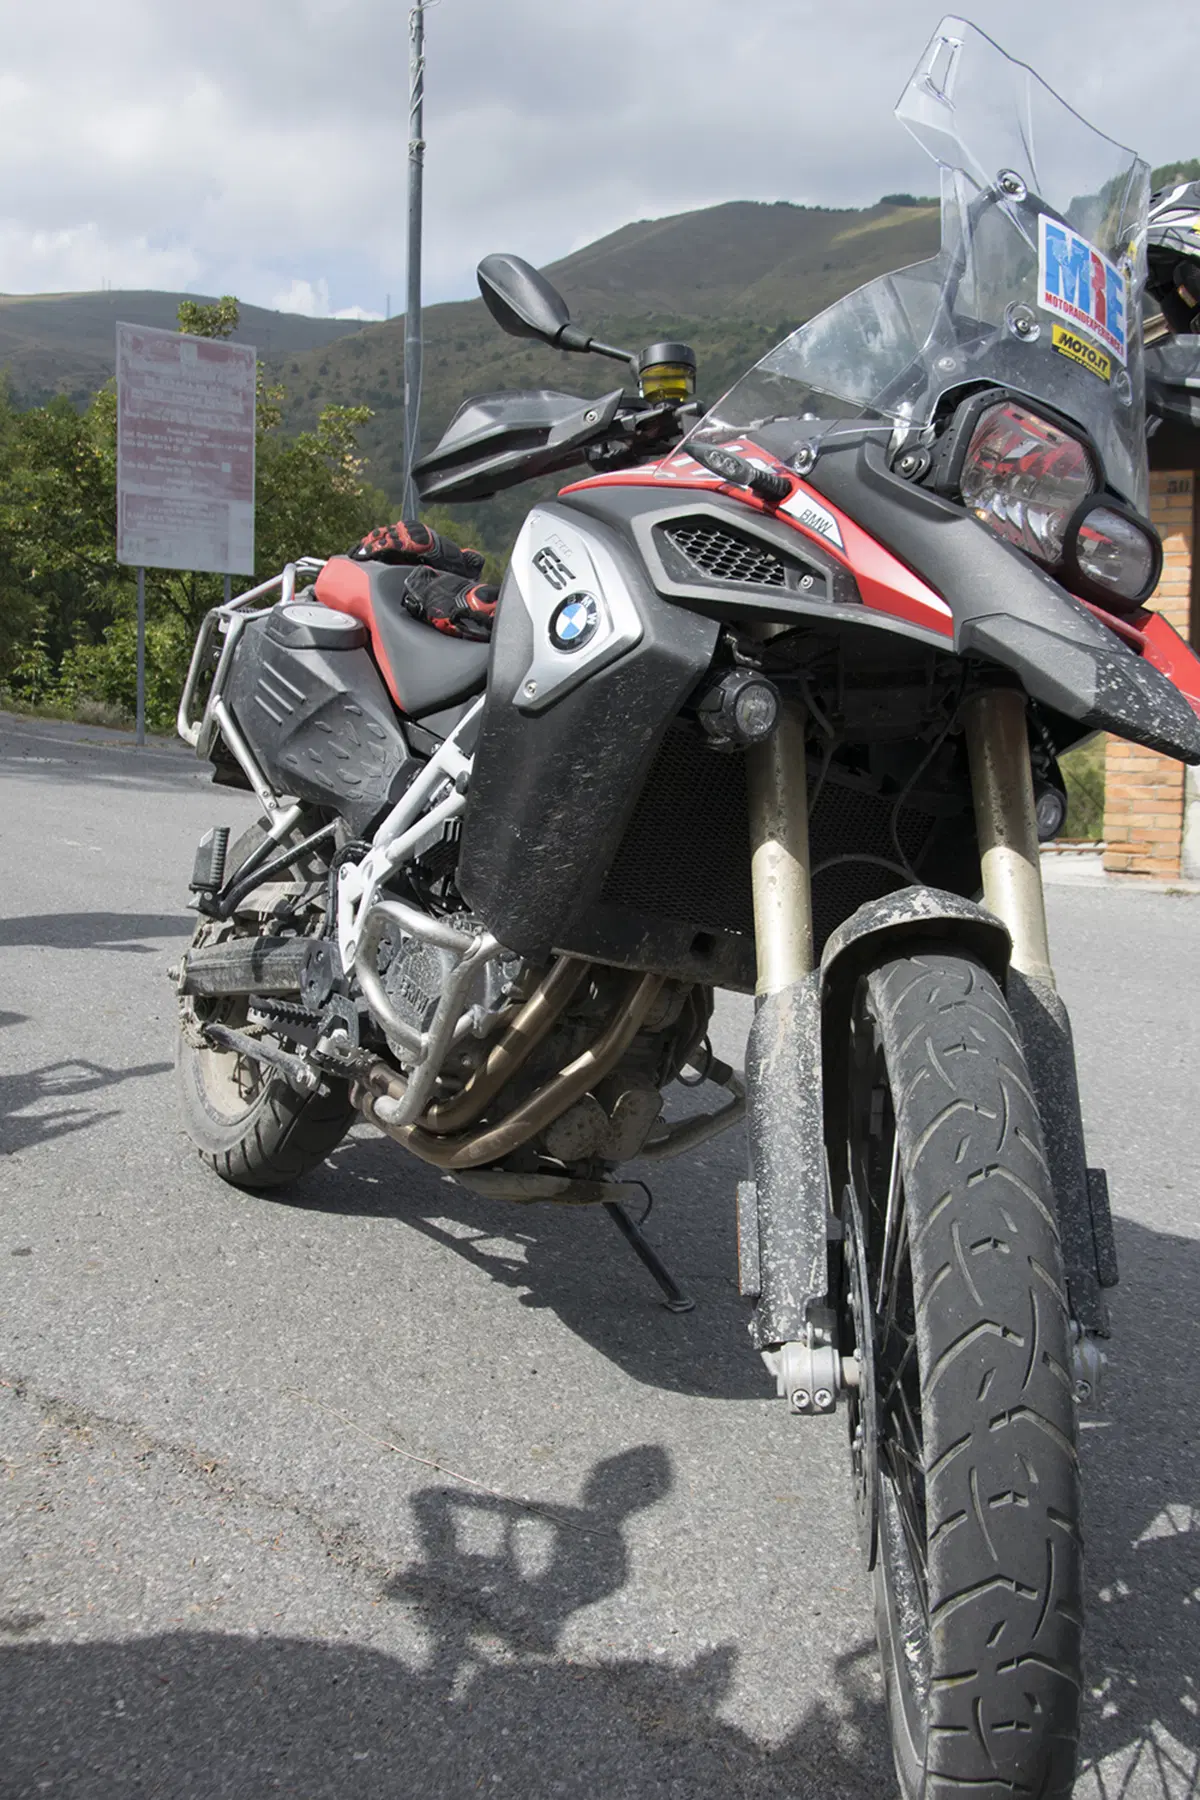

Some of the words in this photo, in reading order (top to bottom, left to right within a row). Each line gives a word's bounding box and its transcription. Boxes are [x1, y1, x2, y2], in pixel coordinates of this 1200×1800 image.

[1058, 331, 1108, 372] MOTO.IT
[800, 508, 834, 533] BMW
[531, 546, 577, 591] GS
[566, 594, 599, 626] BMW
